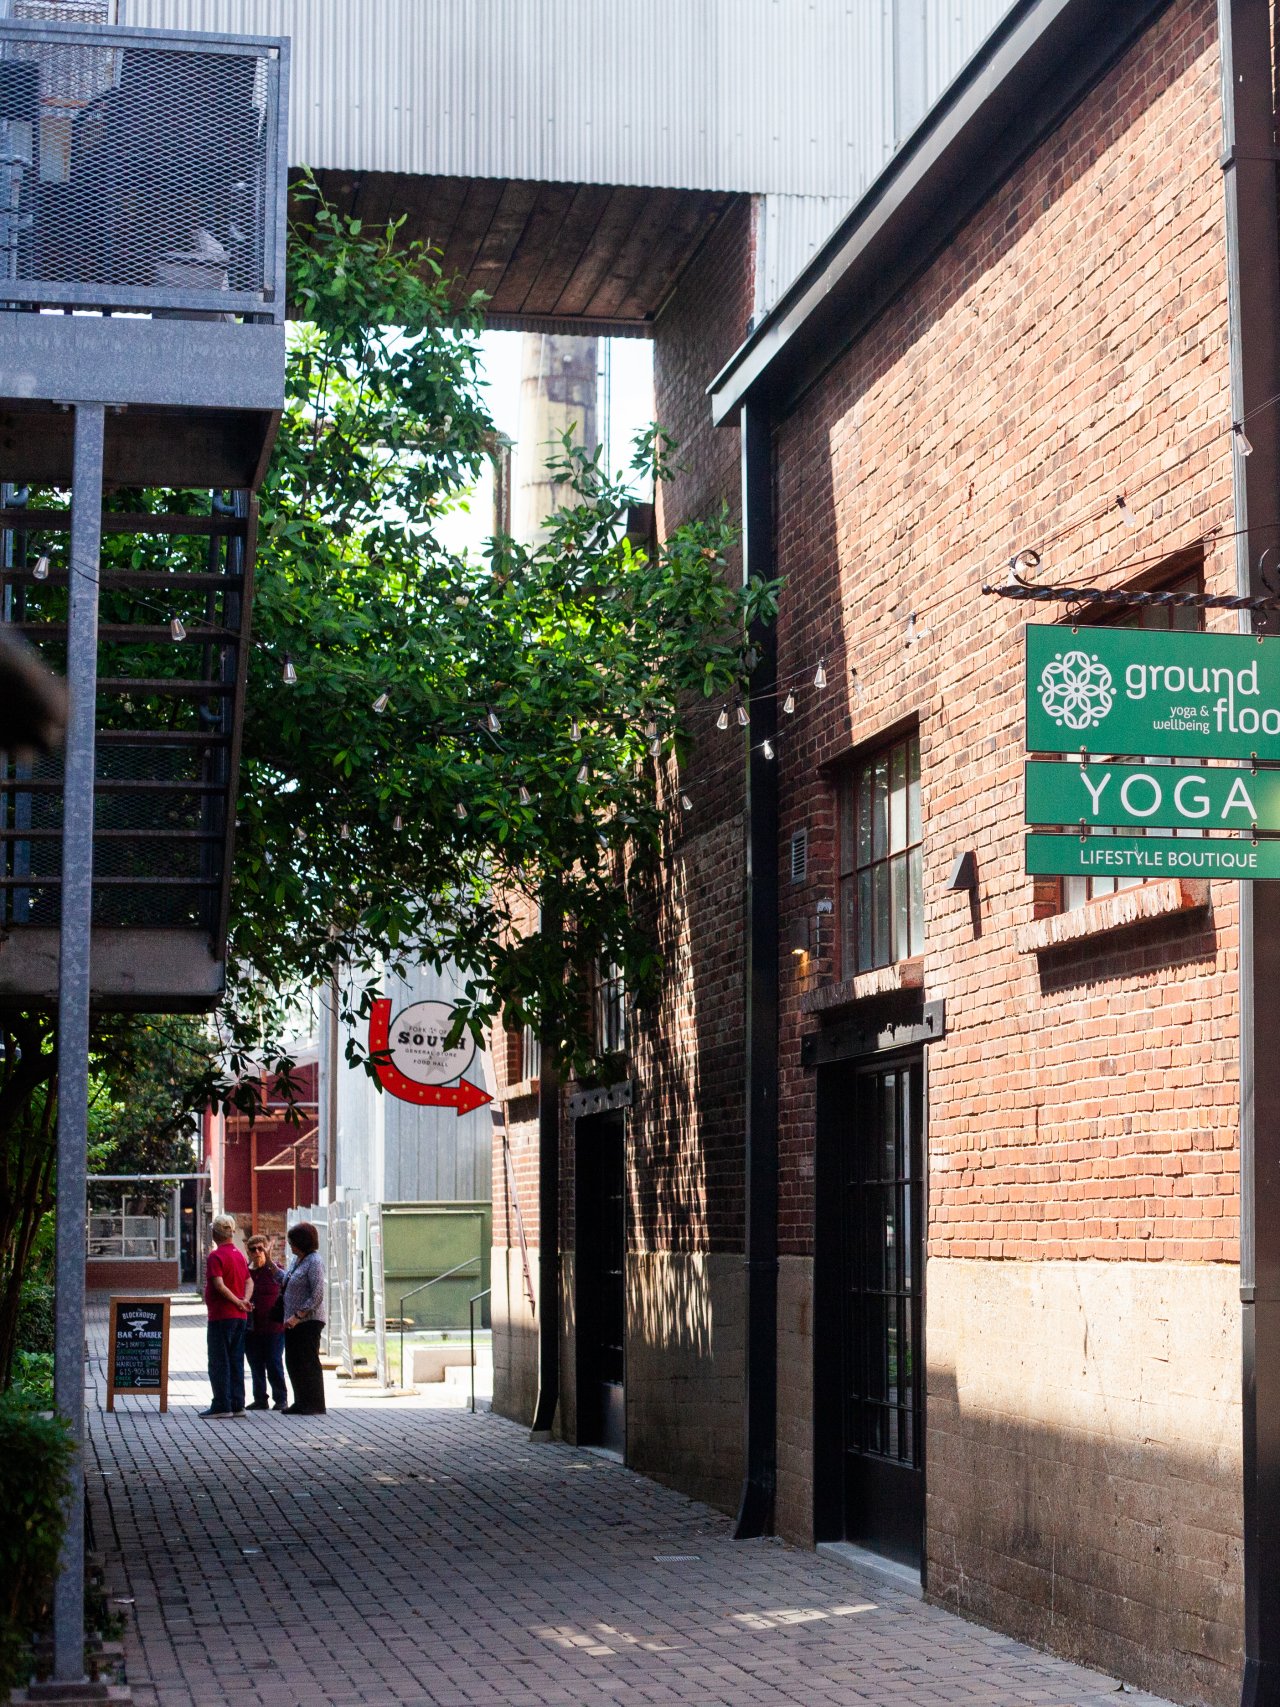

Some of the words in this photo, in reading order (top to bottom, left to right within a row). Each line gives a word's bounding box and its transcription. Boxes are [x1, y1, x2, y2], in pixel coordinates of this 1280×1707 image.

[1125, 660, 1260, 699] ground
[1169, 705, 1197, 719] yoga
[1199, 705, 1210, 717] &
[1153, 719, 1210, 734] wellbeing
[1080, 772, 1258, 820] YOGA
[1080, 850, 1163, 866] LIFESTYLE
[1168, 852, 1258, 868] BOUTIQUE
[405, 1048, 433, 1056] GENERAL
[117, 1331, 133, 1339] BAR
[139, 1331, 162, 1339] BARBER
